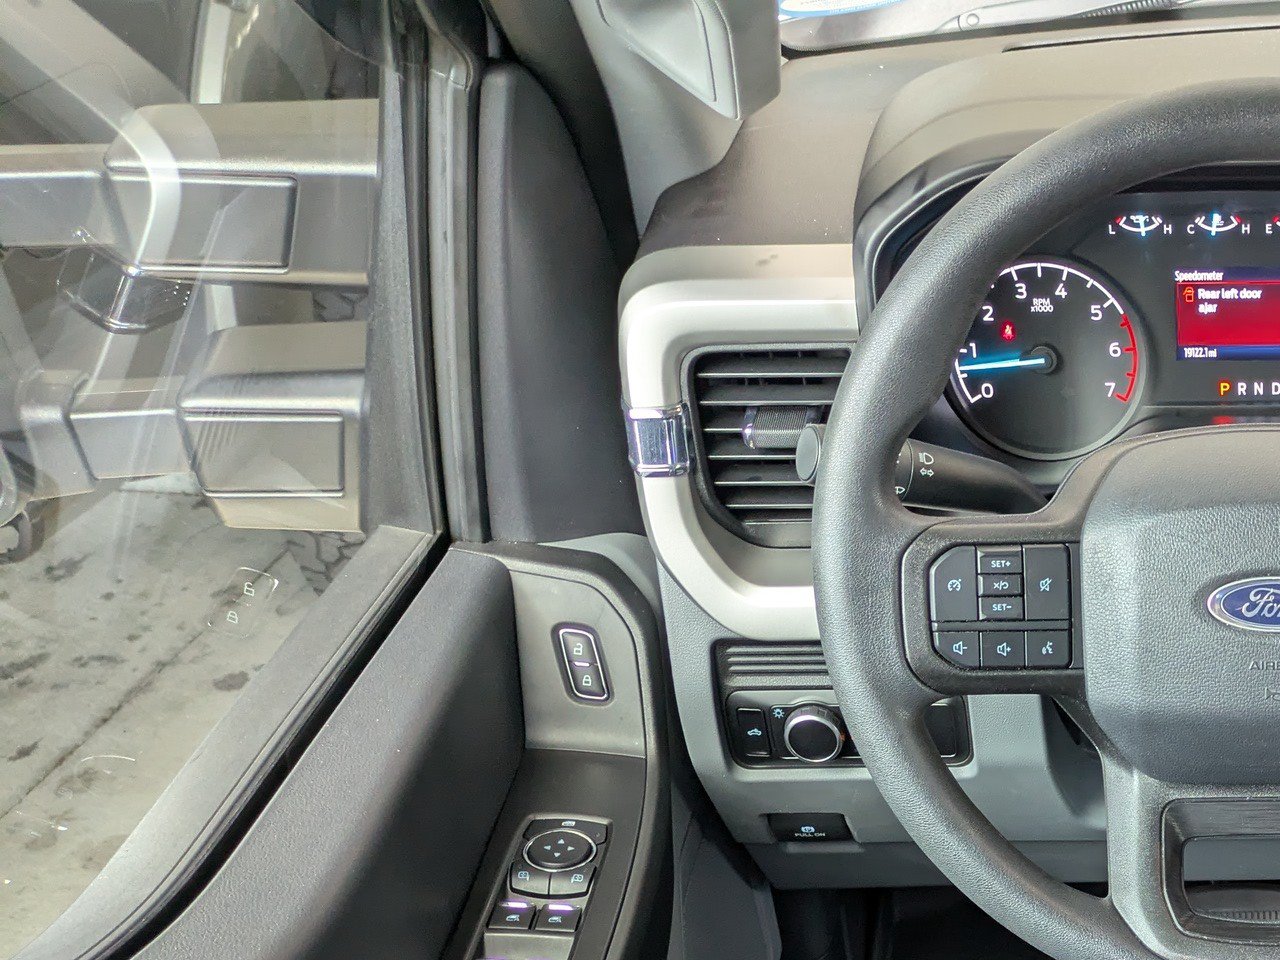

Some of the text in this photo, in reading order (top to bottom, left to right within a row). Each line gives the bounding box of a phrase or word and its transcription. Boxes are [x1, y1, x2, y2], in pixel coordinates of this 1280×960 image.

[1109, 224, 1115, 234] L
[1164, 224, 1172, 234] H
[1187, 224, 1194, 234] C
[1242, 224, 1250, 234] H
[1266, 224, 1272, 234] E
[1174, 271, 1224, 281] Speedometer
[1015, 283, 1027, 299] 3
[1055, 283, 1068, 298] 4
[1198, 288, 1262, 300] Rear left door
[982, 306, 994, 322] 2
[1090, 305, 1102, 321] 5
[1198, 302, 1218, 314] ajar
[970, 343, 976, 358] 1
[1109, 342, 1122, 358] 6
[982, 383, 994, 398] 0
[1104, 382, 1116, 398] 7
[1220, 382, 1230, 395] P
[1238, 382, 1246, 395] R
[1254, 382, 1264, 395] N
